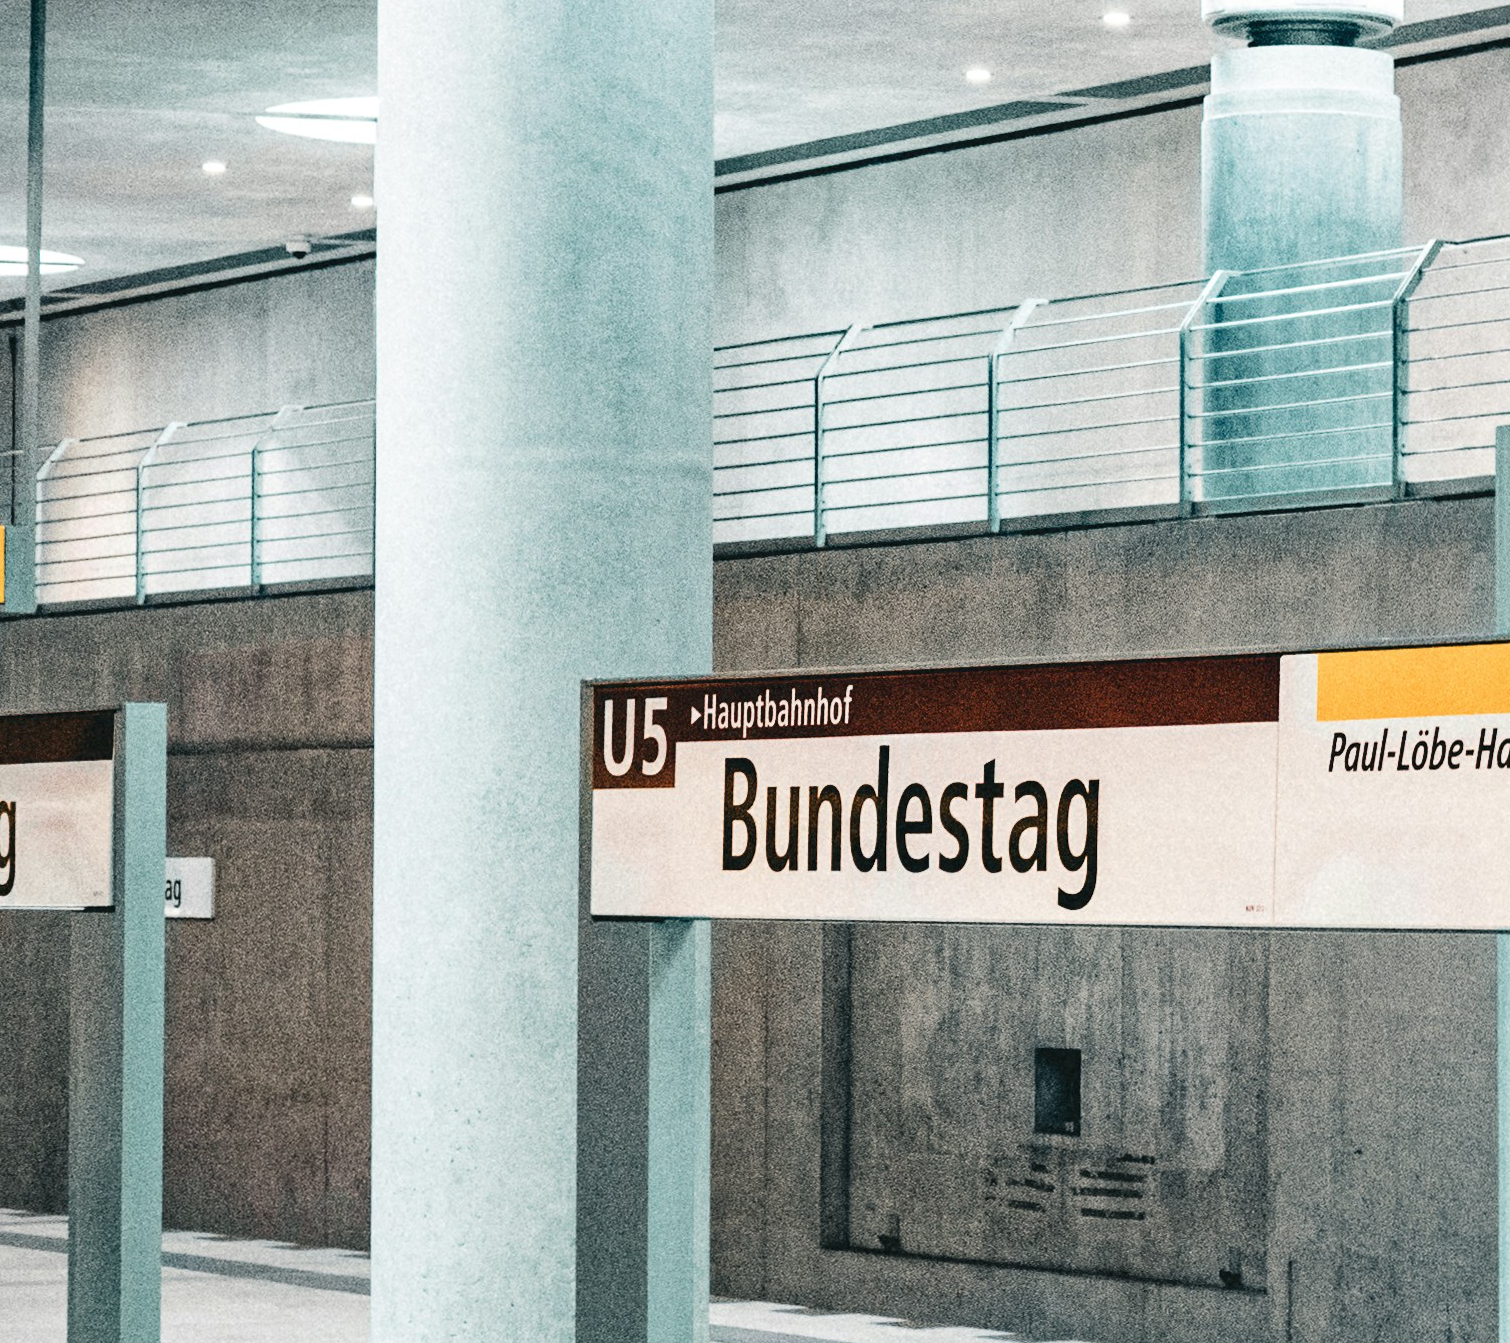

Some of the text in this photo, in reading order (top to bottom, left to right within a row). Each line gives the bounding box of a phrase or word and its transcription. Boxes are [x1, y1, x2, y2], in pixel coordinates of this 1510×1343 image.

[603, 685, 853, 777] U5 Hauptbahnhof
[721, 744, 1101, 911] Bundestag
